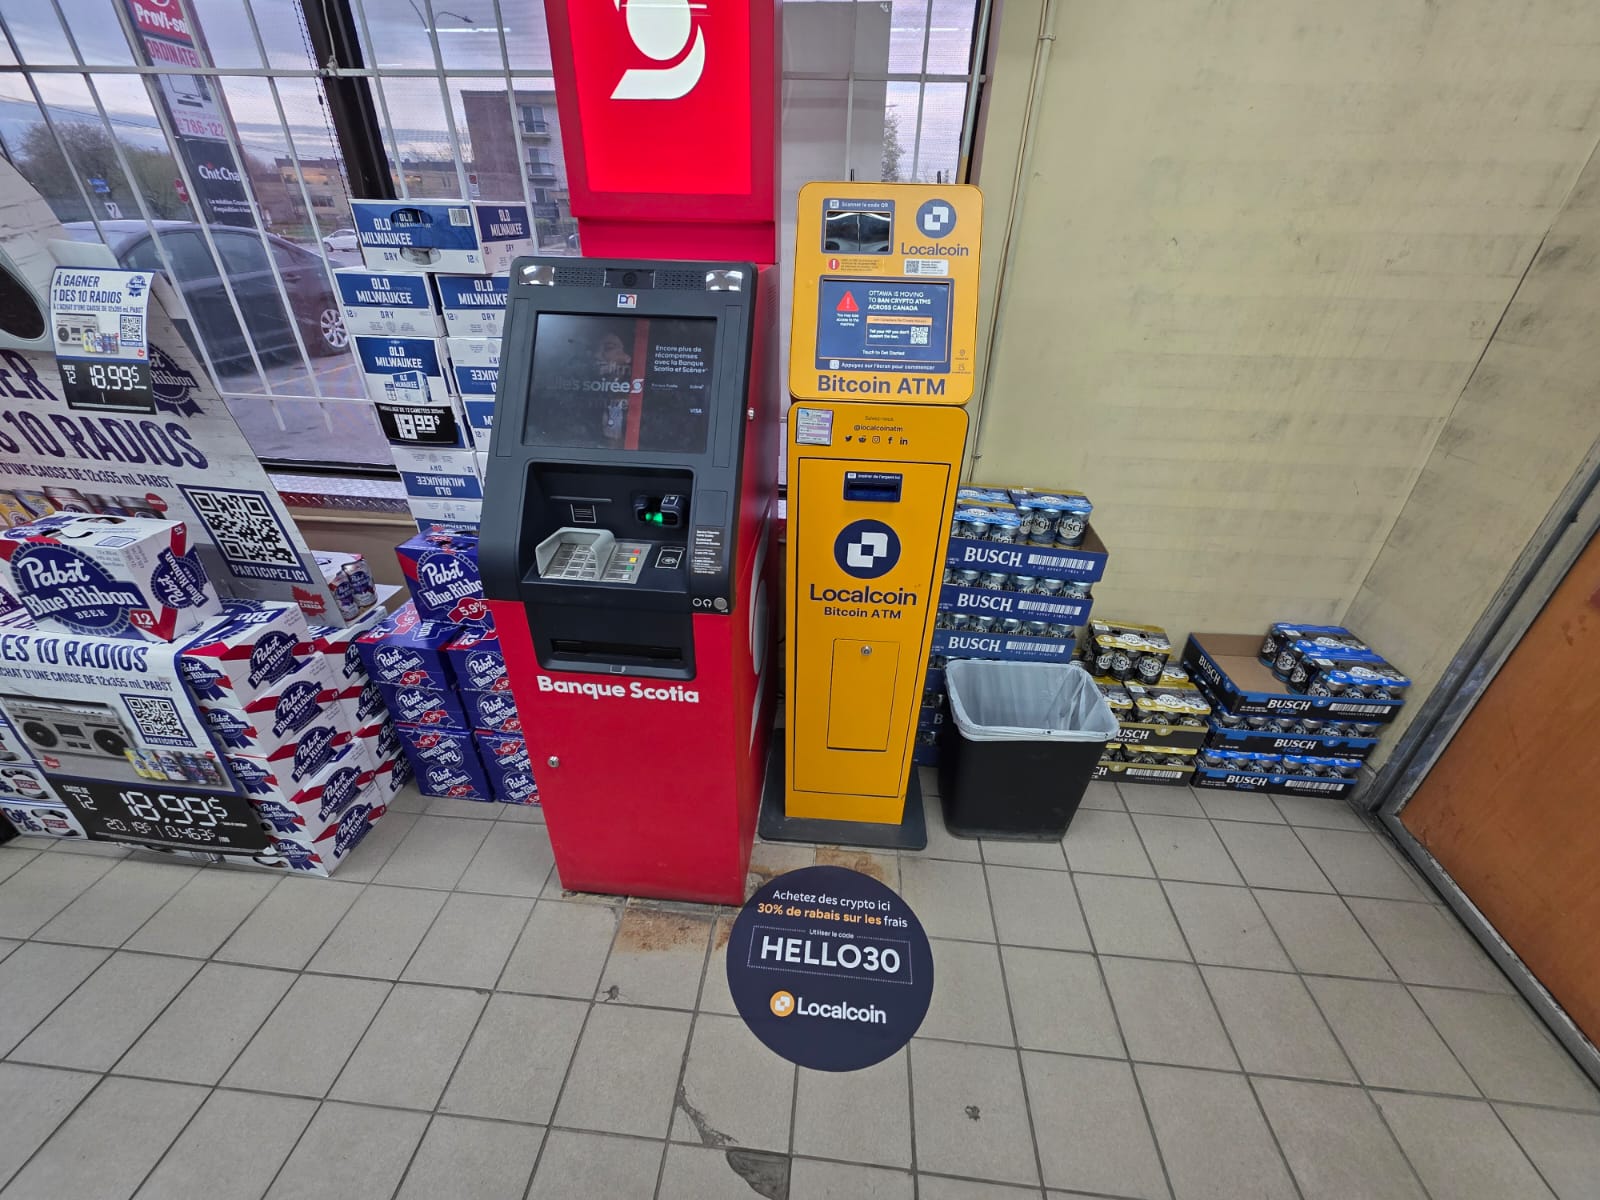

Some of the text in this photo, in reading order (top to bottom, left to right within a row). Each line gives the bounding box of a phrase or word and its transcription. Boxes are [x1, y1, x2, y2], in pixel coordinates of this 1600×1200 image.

[373, 218, 391, 230] OLD
[490, 222, 523, 236] MILWAUKEE
[360, 232, 413, 245] MILWAUKEE
[384, 252, 398, 261] DRY
[901, 242, 969, 257] Localcoin
[63, 274, 100, 287] GAGNER
[371, 278, 390, 290] OLD
[474, 280, 493, 291] OLD
[53, 289, 122, 304] 1 DES 10 RADIOS
[356, 291, 413, 304] MILWAUKEE
[457, 293, 507, 305] MILWAUKE
[389, 346, 405, 356] OLD
[375, 357, 423, 368] MILWAUKEE
[66, 371, 76, 384] 12
[818, 375, 945, 395] Bitcoin ATM
[853, 424, 903, 432] @localcoinatm
[2, 410, 66, 457] 10
[48, 413, 208, 469] RADIOS
[5, 463, 174, 488] D'UNE CAISSE DE 12x355 mL PABST
[416, 476, 465, 487] MILWAUKEE
[964, 546, 1023, 568] BUSCH
[17, 556, 90, 588] Pabst
[231, 564, 309, 581] PARTICIPEZ ICI
[421, 559, 464, 587] Pabst
[21, 591, 65, 617] Blue
[62, 585, 142, 612] Ribbon
[186, 584, 205, 605] Blue
[424, 590, 453, 607] Blue
[809, 583, 917, 606] Localcoin
[957, 593, 1013, 612] BUSCH
[75, 609, 107, 619] BEER
[458, 601, 488, 616] 5.9%
[824, 607, 902, 619] Bitcoin ATM
[133, 610, 154, 626] 12
[0, 634, 149, 672] ES 10 RADIOS
[253, 636, 281, 664] Pabst
[948, 636, 1002, 653] BUSCH
[251, 639, 296, 685] Blue Ribbon
[345, 657, 361, 676] Blue
[377, 650, 402, 667] Pabst
[394, 657, 421, 674] Ribbon
[469, 655, 496, 674] Pabst
[1198, 655, 1221, 686] BUSCH
[24, 669, 174, 692] D'UNE CAISSE DE 12x355 mL PABST
[536, 675, 699, 703] Banque Scotia
[278, 685, 306, 715] Pabst
[400, 691, 423, 707] Pabst
[415, 699, 441, 713] Ribbon
[480, 697, 506, 714] Pabst
[1267, 699, 1312, 711] BUSCH
[275, 687, 321, 735] Blue Ribbon
[1117, 729, 1150, 740] USCH
[297, 731, 321, 760] Pabst
[1273, 738, 1317, 750] BUSCH
[294, 731, 335, 779] Blue Ribbon
[428, 768, 453, 783] Pabst
[505, 775, 528, 789] Pabst
[1226, 774, 1268, 787] BUSCH
[323, 771, 348, 800] Pabst
[72, 793, 97, 811] 12
[321, 771, 360, 819] Blue Ribbon
[335, 808, 370, 855] Blue Ribbon
[339, 808, 358, 838] Pabst
[772, 890, 891, 912] Achetez des crypto ici
[757, 902, 908, 928] 30% de rabais sur les frais
[809, 928, 854, 939] Utiliser le code
[760, 935, 901, 974] HELLO30
[797, 997, 887, 1024] Localcoin
